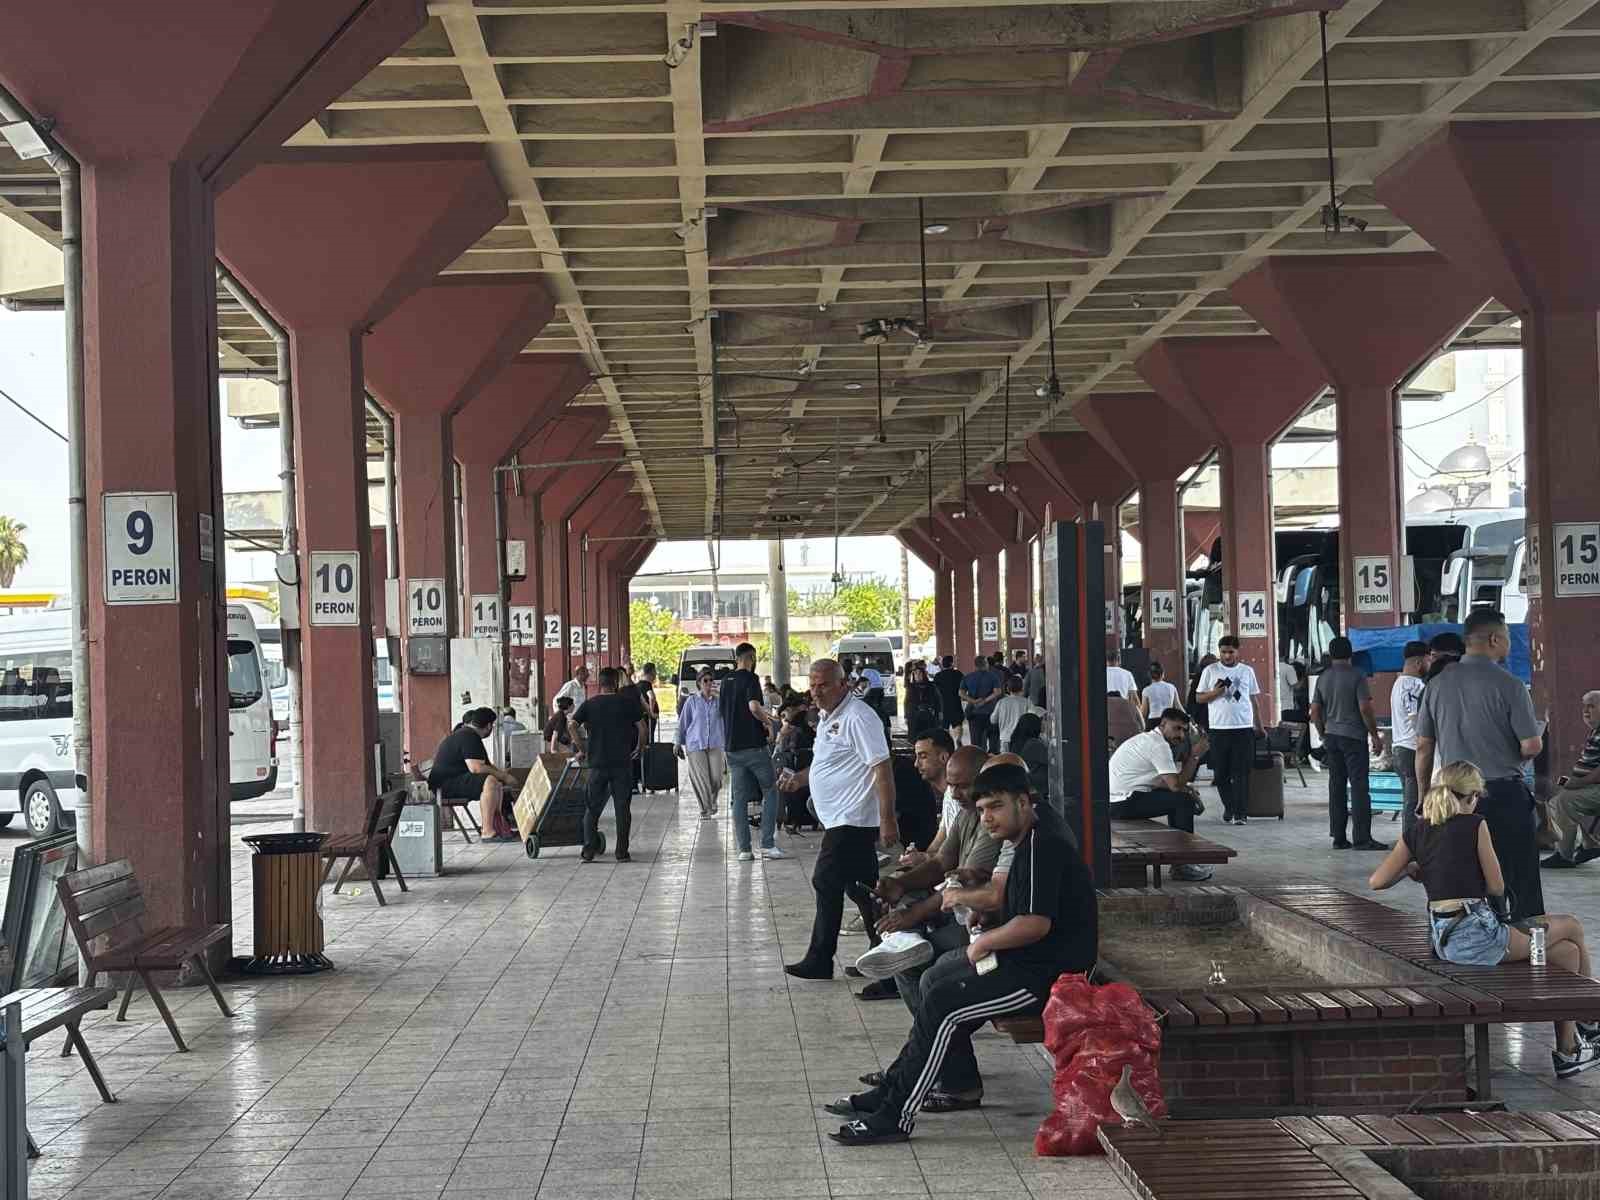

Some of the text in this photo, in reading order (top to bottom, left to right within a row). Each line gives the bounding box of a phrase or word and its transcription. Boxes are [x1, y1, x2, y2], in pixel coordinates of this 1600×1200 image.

[127, 510, 153, 555] 9
[1561, 534, 1598, 565] 15
[112, 568, 171, 586] PERON
[316, 563, 353, 593] 10
[1358, 564, 1388, 588] 15
[1560, 573, 1600, 585] PERON
[412, 587, 441, 611] 10
[1153, 596, 1173, 613] 14
[1358, 595, 1389, 604] PERON
[315, 602, 354, 614] PERON
[474, 601, 497, 621] 11
[1241, 599, 1264, 618] 14
[513, 612, 532, 628] 11
[985, 621, 997, 632] 13
[1013, 617, 1026, 629] 13
[1241, 622, 1265, 630] PERON
[474, 625, 499, 633] PERON
